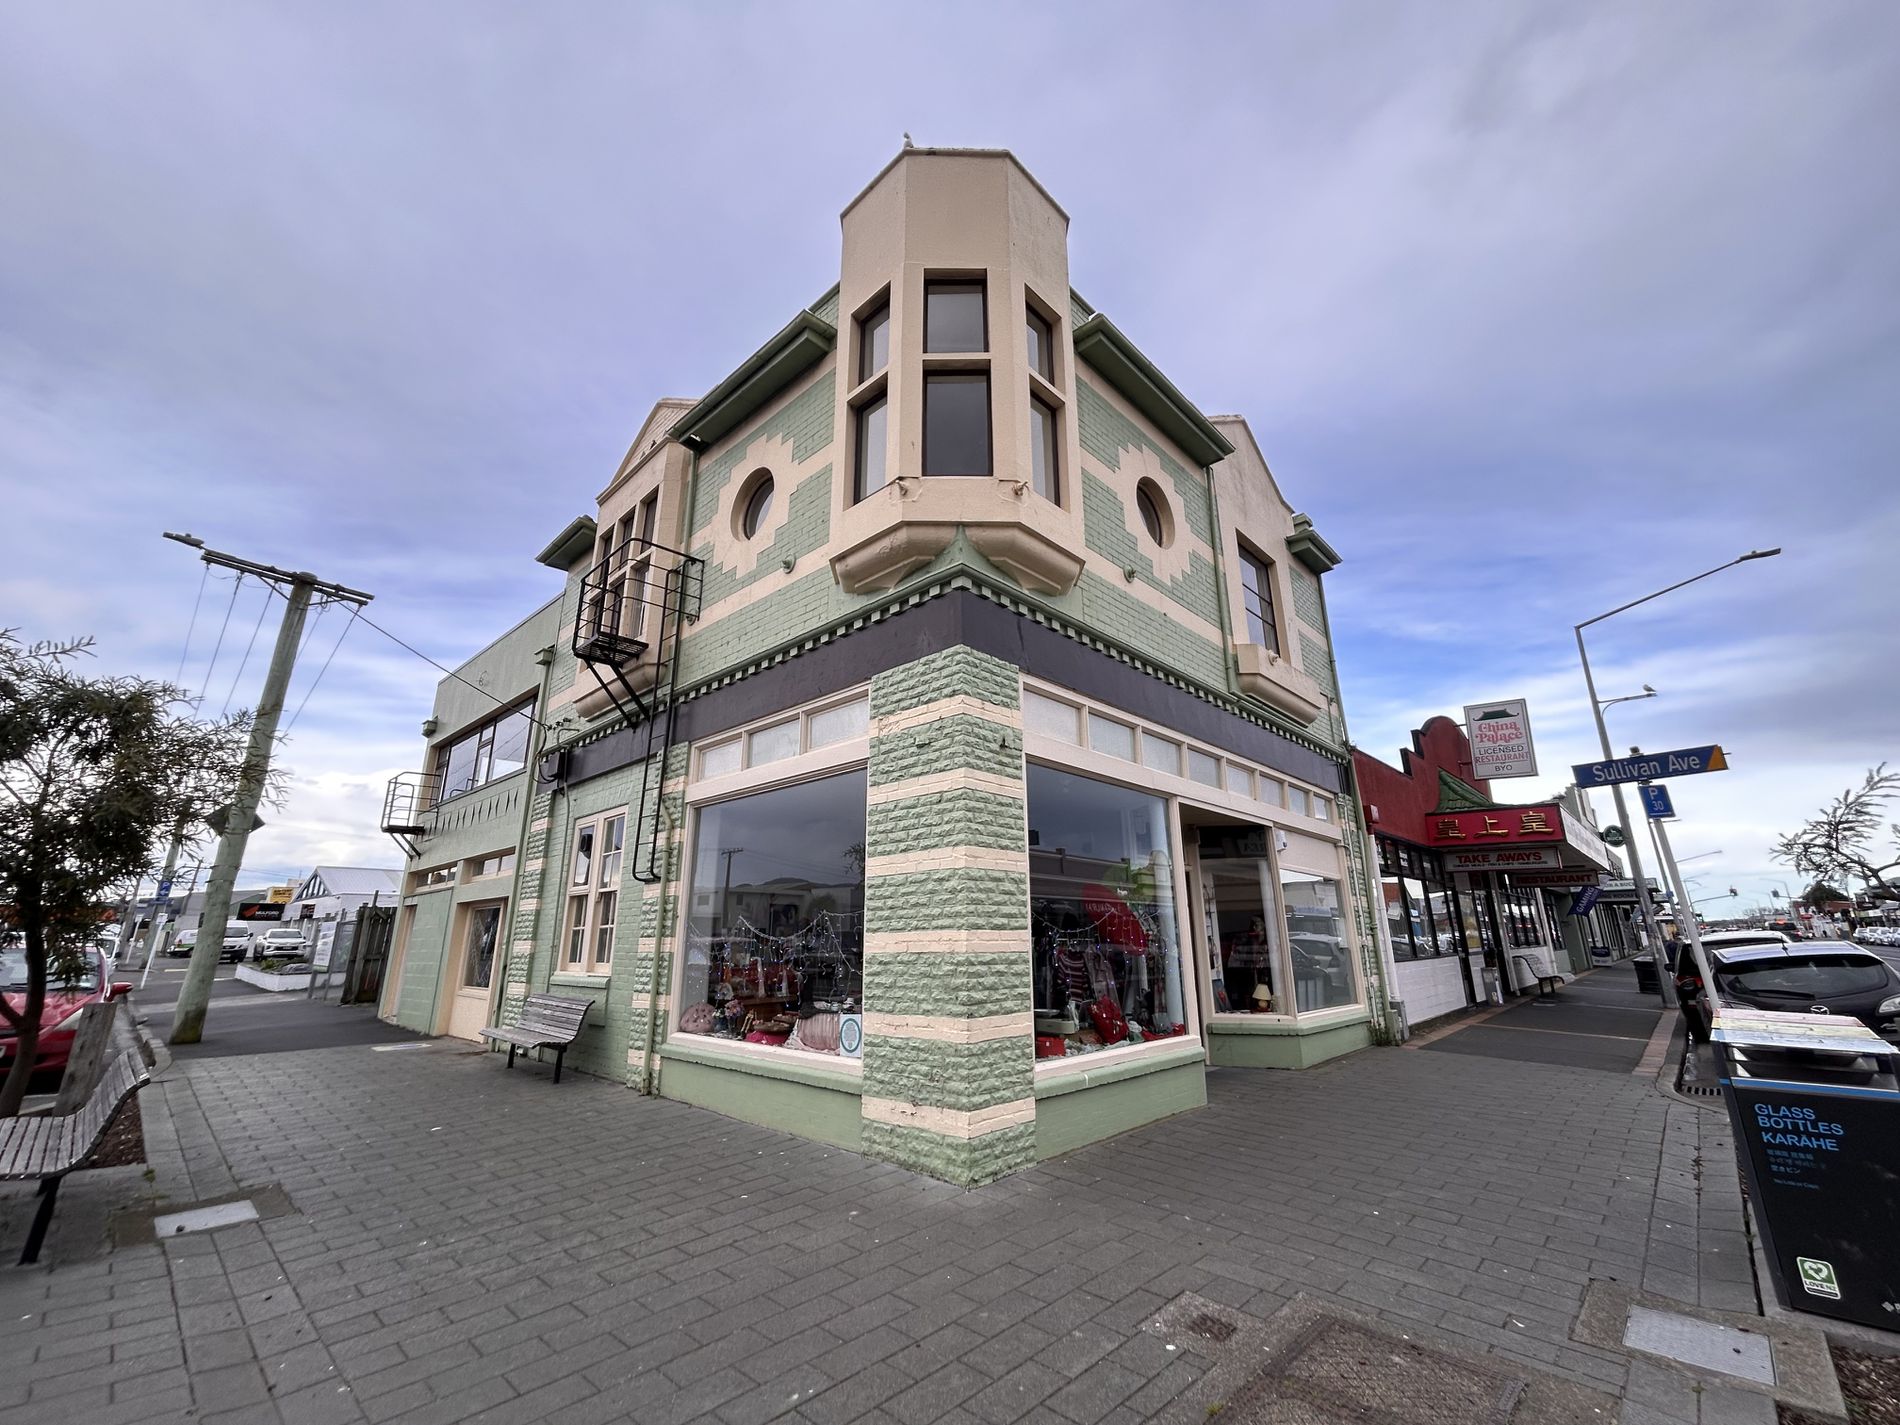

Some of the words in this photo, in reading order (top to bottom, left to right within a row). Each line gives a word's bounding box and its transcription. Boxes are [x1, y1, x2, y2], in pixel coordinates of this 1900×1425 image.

[1478, 721, 1520, 733] China
[1475, 731, 1523, 744] Palace
[1479, 745, 1524, 755] LICENSED
[1475, 752, 1529, 763] RESTAURANT
[1494, 764, 1513, 772] BYO
[1592, 761, 1661, 782] Sullivan
[1668, 754, 1700, 772] Ave
[1648, 787, 1658, 800] P
[1652, 800, 1664, 811] 30
[1435, 811, 1555, 838] 皇上皇
[1456, 854, 1490, 864] TAKE
[1496, 851, 1542, 862] AWAYS
[1516, 874, 1593, 884] RESTAURANT
[1576, 886, 1595, 913] GAMING
[1754, 1103, 1816, 1120] GLASS
[1757, 1115, 1844, 1135] BOTTLES
[1804, 1280, 1824, 1289] LOVE
